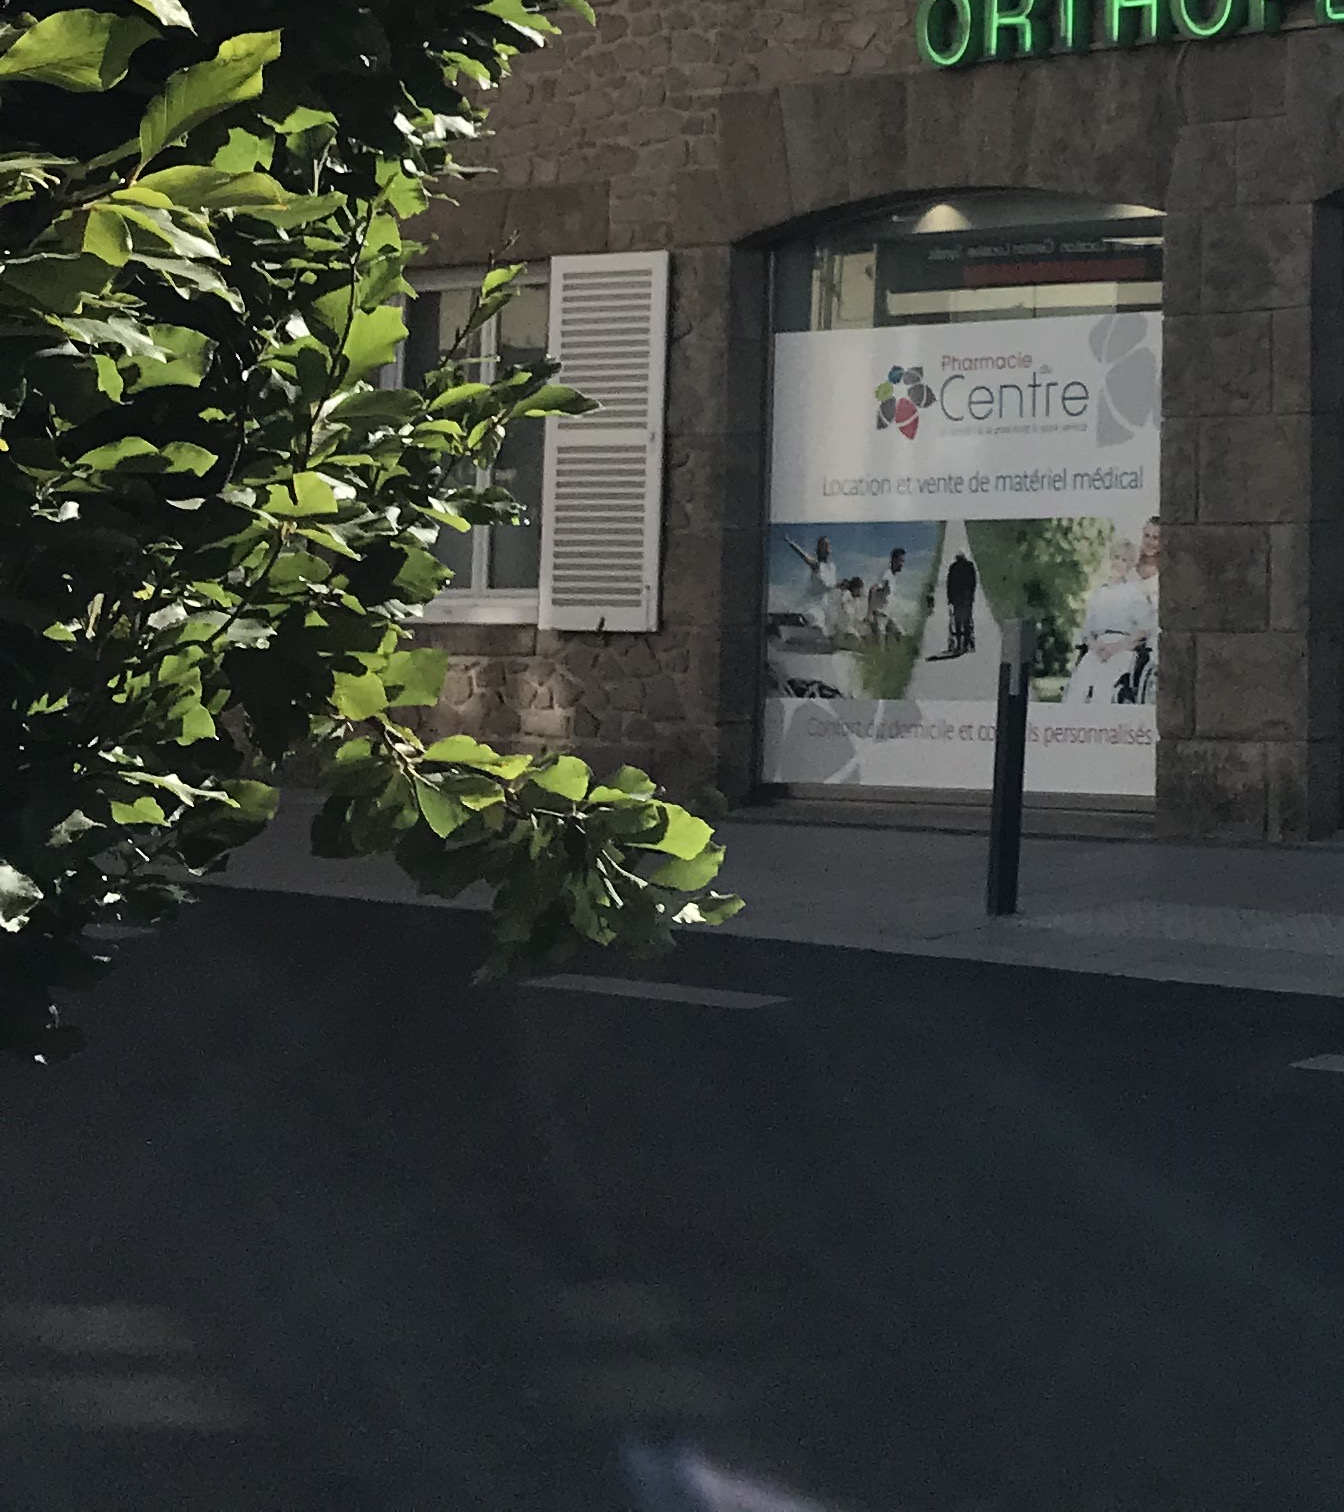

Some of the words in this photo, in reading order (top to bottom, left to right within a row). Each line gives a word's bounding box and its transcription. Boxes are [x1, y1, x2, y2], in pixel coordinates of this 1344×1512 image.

[941, 352, 1033, 371] Pharmacie
[940, 372, 1090, 422] Centre
[823, 474, 892, 497] Location
[897, 476, 912, 496] et
[917, 475, 964, 494] vente
[969, 471, 990, 494] de
[995, 468, 1067, 493] matériel
[1073, 465, 1144, 491] médical
[959, 723, 974, 741] et
[1045, 723, 1153, 747] personnalisés
